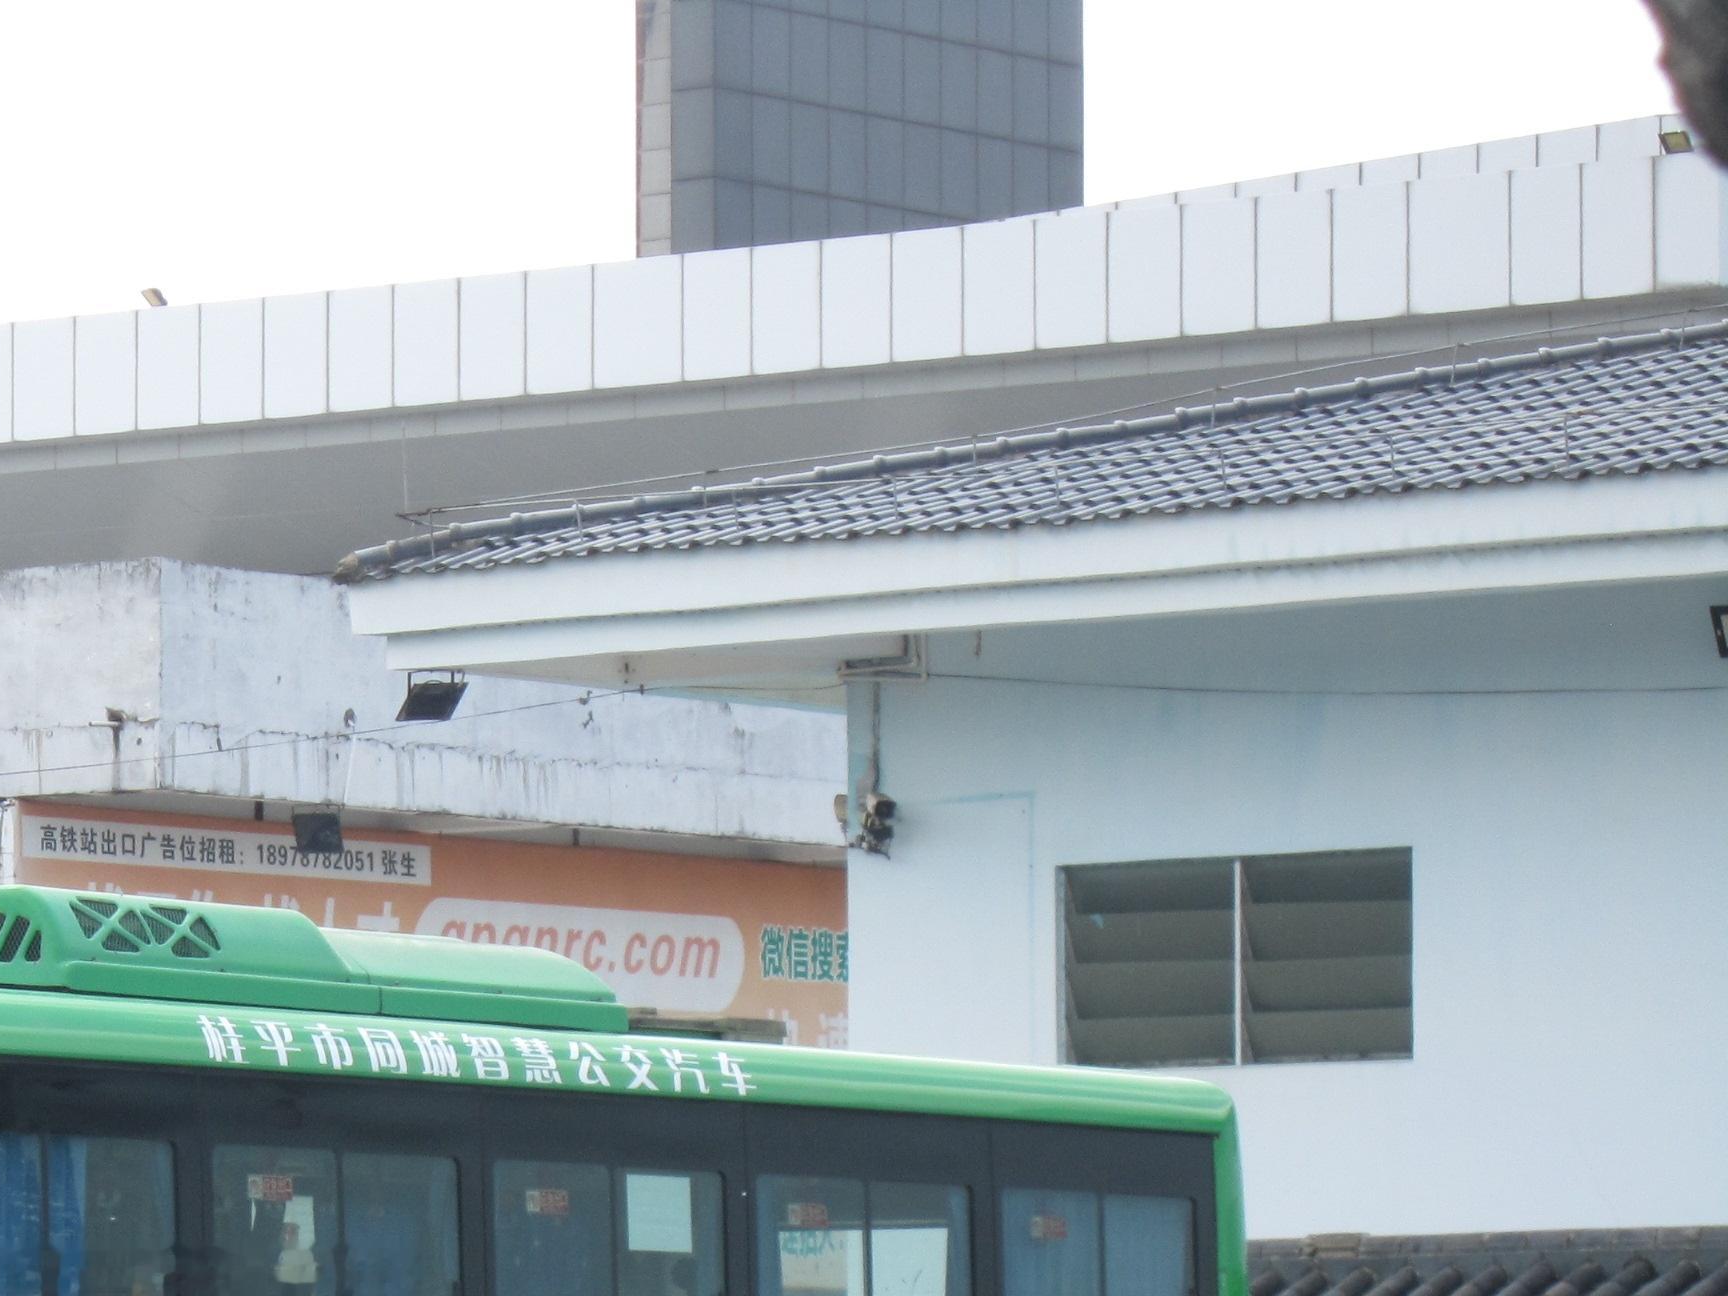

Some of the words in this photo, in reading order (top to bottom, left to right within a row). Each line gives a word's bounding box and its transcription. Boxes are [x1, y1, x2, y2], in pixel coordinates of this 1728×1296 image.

[40, 824, 244, 866] 高铁站出口广告位招租：
[257, 844, 374, 872] 18978782051
[382, 850, 417, 878] 张生
[197, 1015, 757, 1096] 桂平市同城智慧公交汽车
